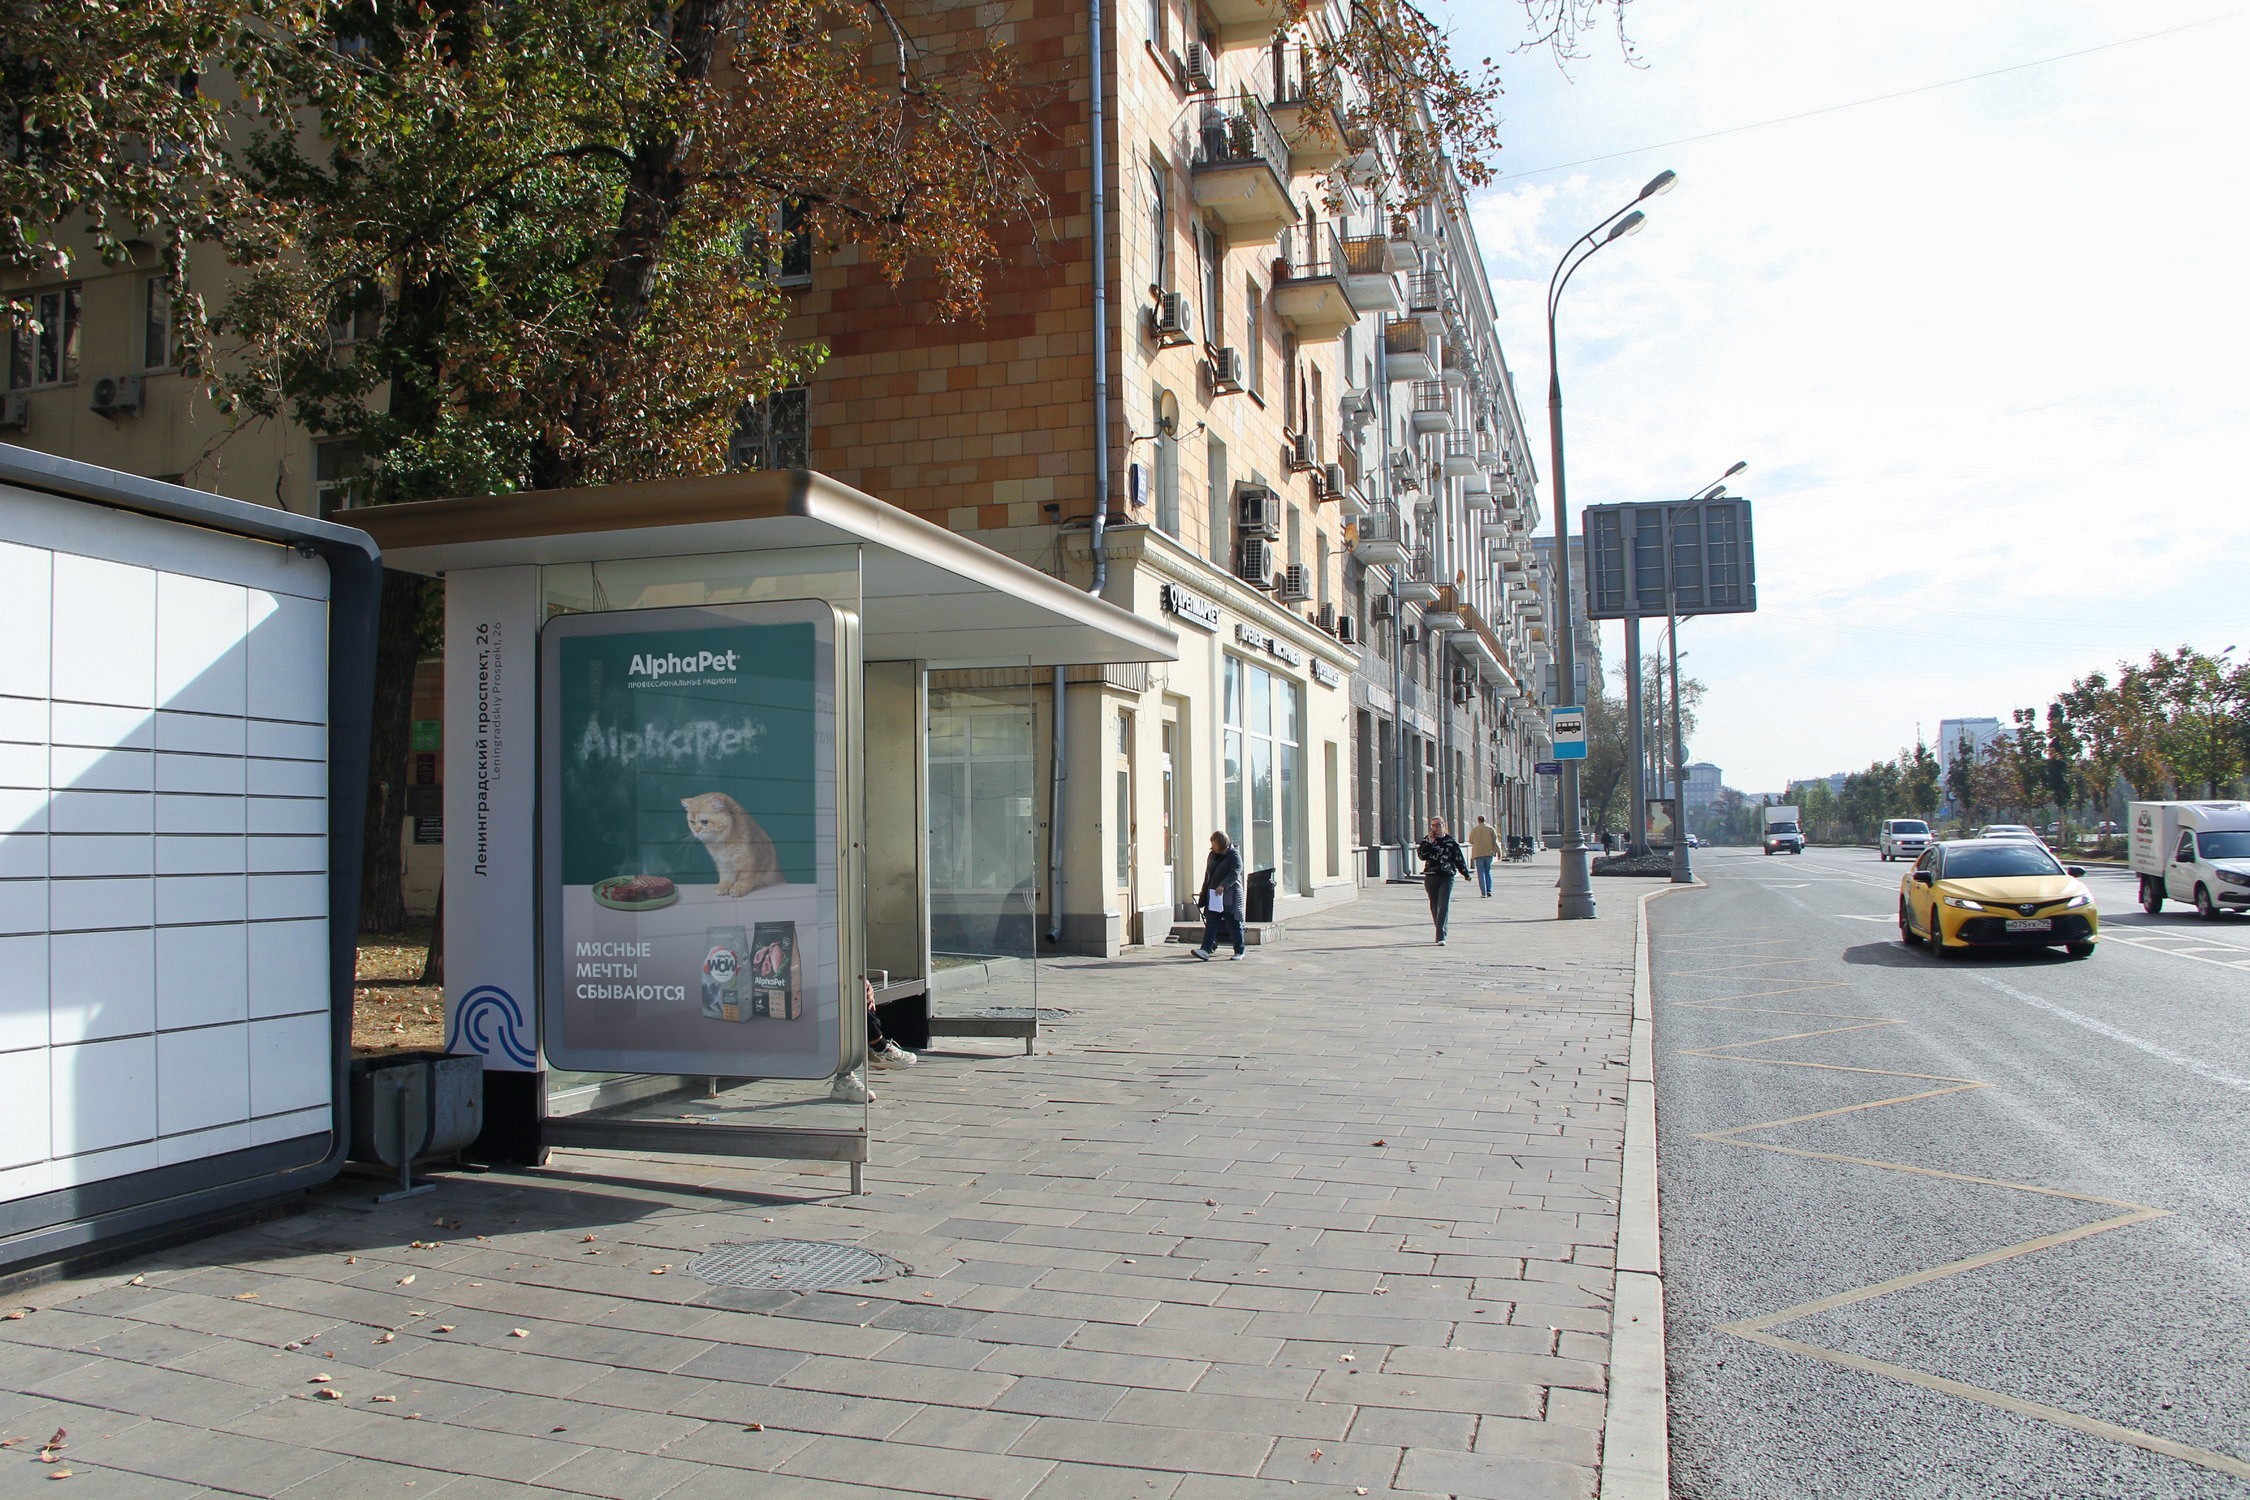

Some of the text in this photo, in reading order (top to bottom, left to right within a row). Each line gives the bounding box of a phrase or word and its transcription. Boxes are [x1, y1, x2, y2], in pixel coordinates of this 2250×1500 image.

[628, 650, 737, 679] AlphaPet
[628, 677, 737, 689] ПРОФЕССИОНАЛЬНЫЕ РАЦИОНЫ
[492, 622, 503, 780] Leningradskiy Prospekt, 26
[475, 623, 491, 877] Ленинградский проспект, 26
[579, 718, 757, 767] AlphaPet
[576, 942, 651, 957] МЯСНЫЕ
[576, 963, 638, 978] МЕЧТЫ
[576, 984, 685, 1000] СБЫВАЮТСЯ
